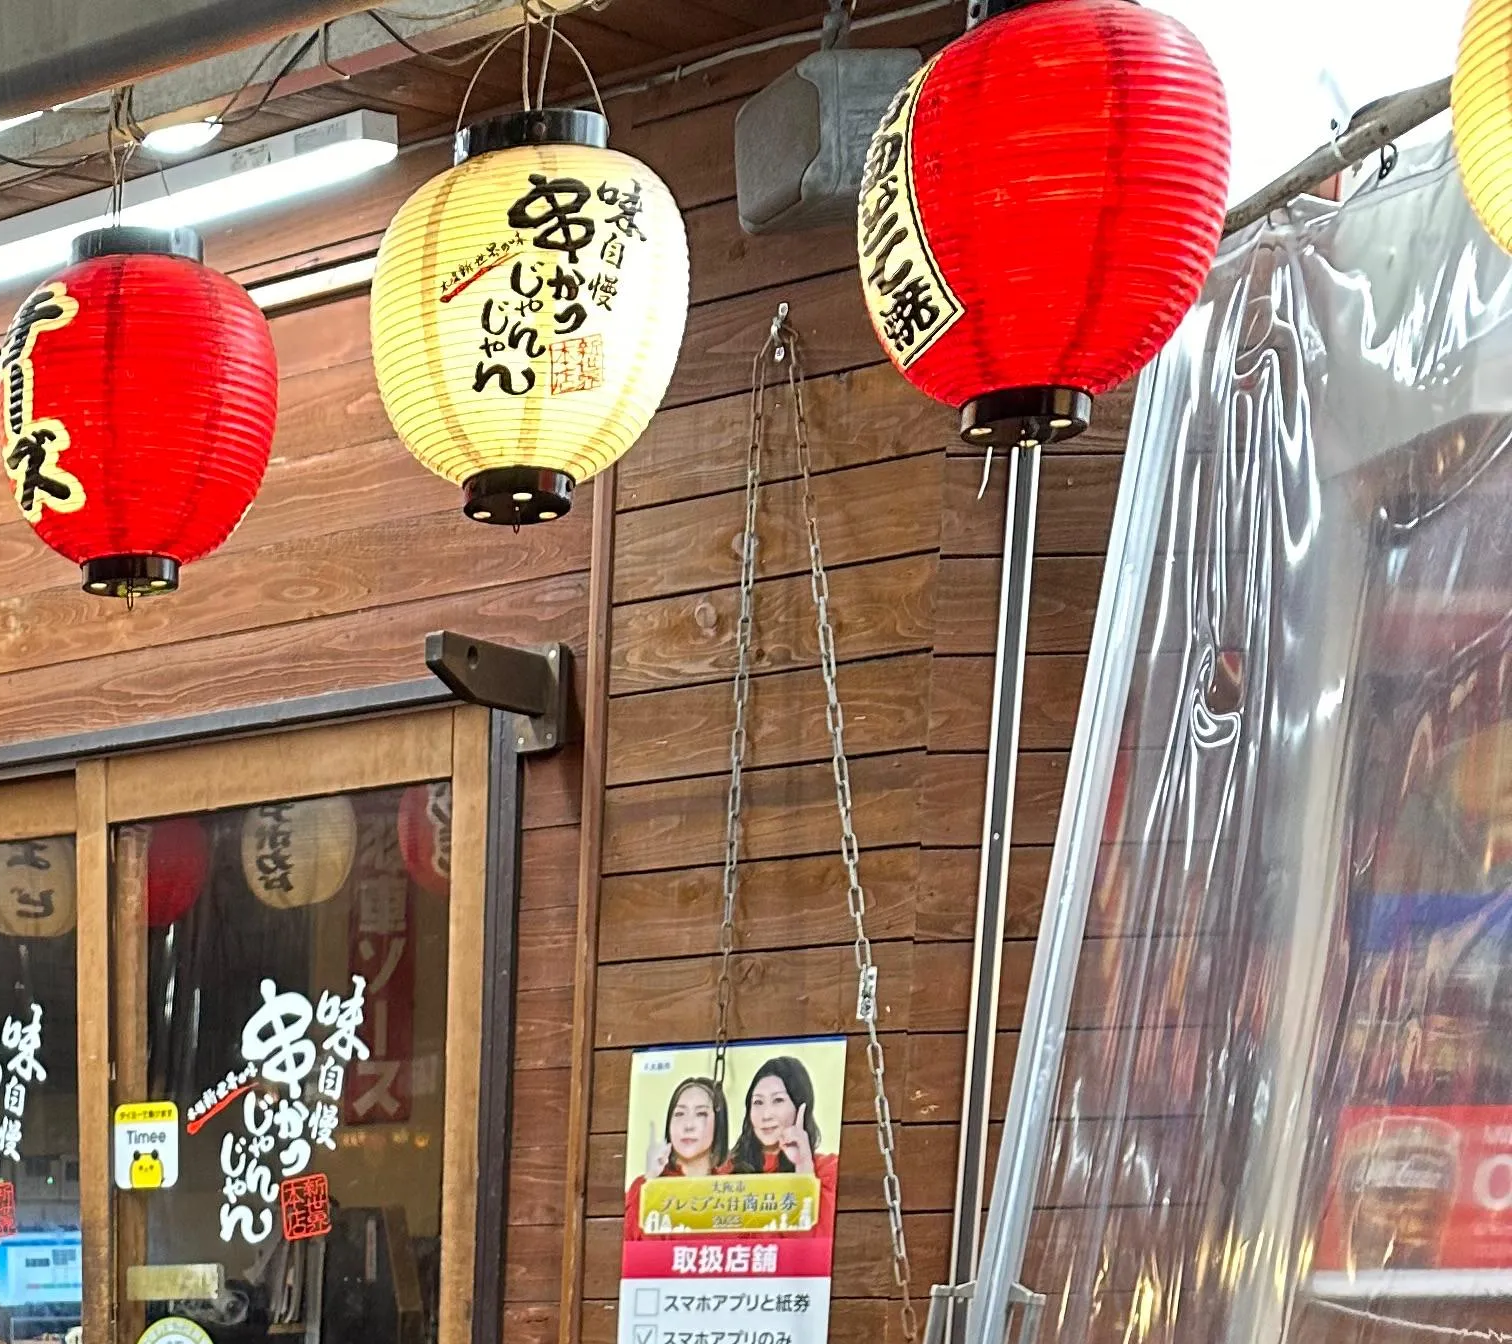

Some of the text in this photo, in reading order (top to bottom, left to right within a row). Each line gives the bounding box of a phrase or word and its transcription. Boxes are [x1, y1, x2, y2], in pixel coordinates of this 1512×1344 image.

[507, 173, 595, 334] 串かつ
[588, 179, 647, 311] 味自慢
[3, 291, 71, 510] チーズ
[219, 979, 316, 1244] 串かつ じゃん じゃん
[309, 975, 370, 1151] 味自慢
[126, 1129, 167, 1146] Timee
[660, 1192, 797, 1213] プレミアム付商品券
[663, 1293, 811, 1313] スマホアプリと紙券
[671, 1244, 779, 1274] 取扱店舗
